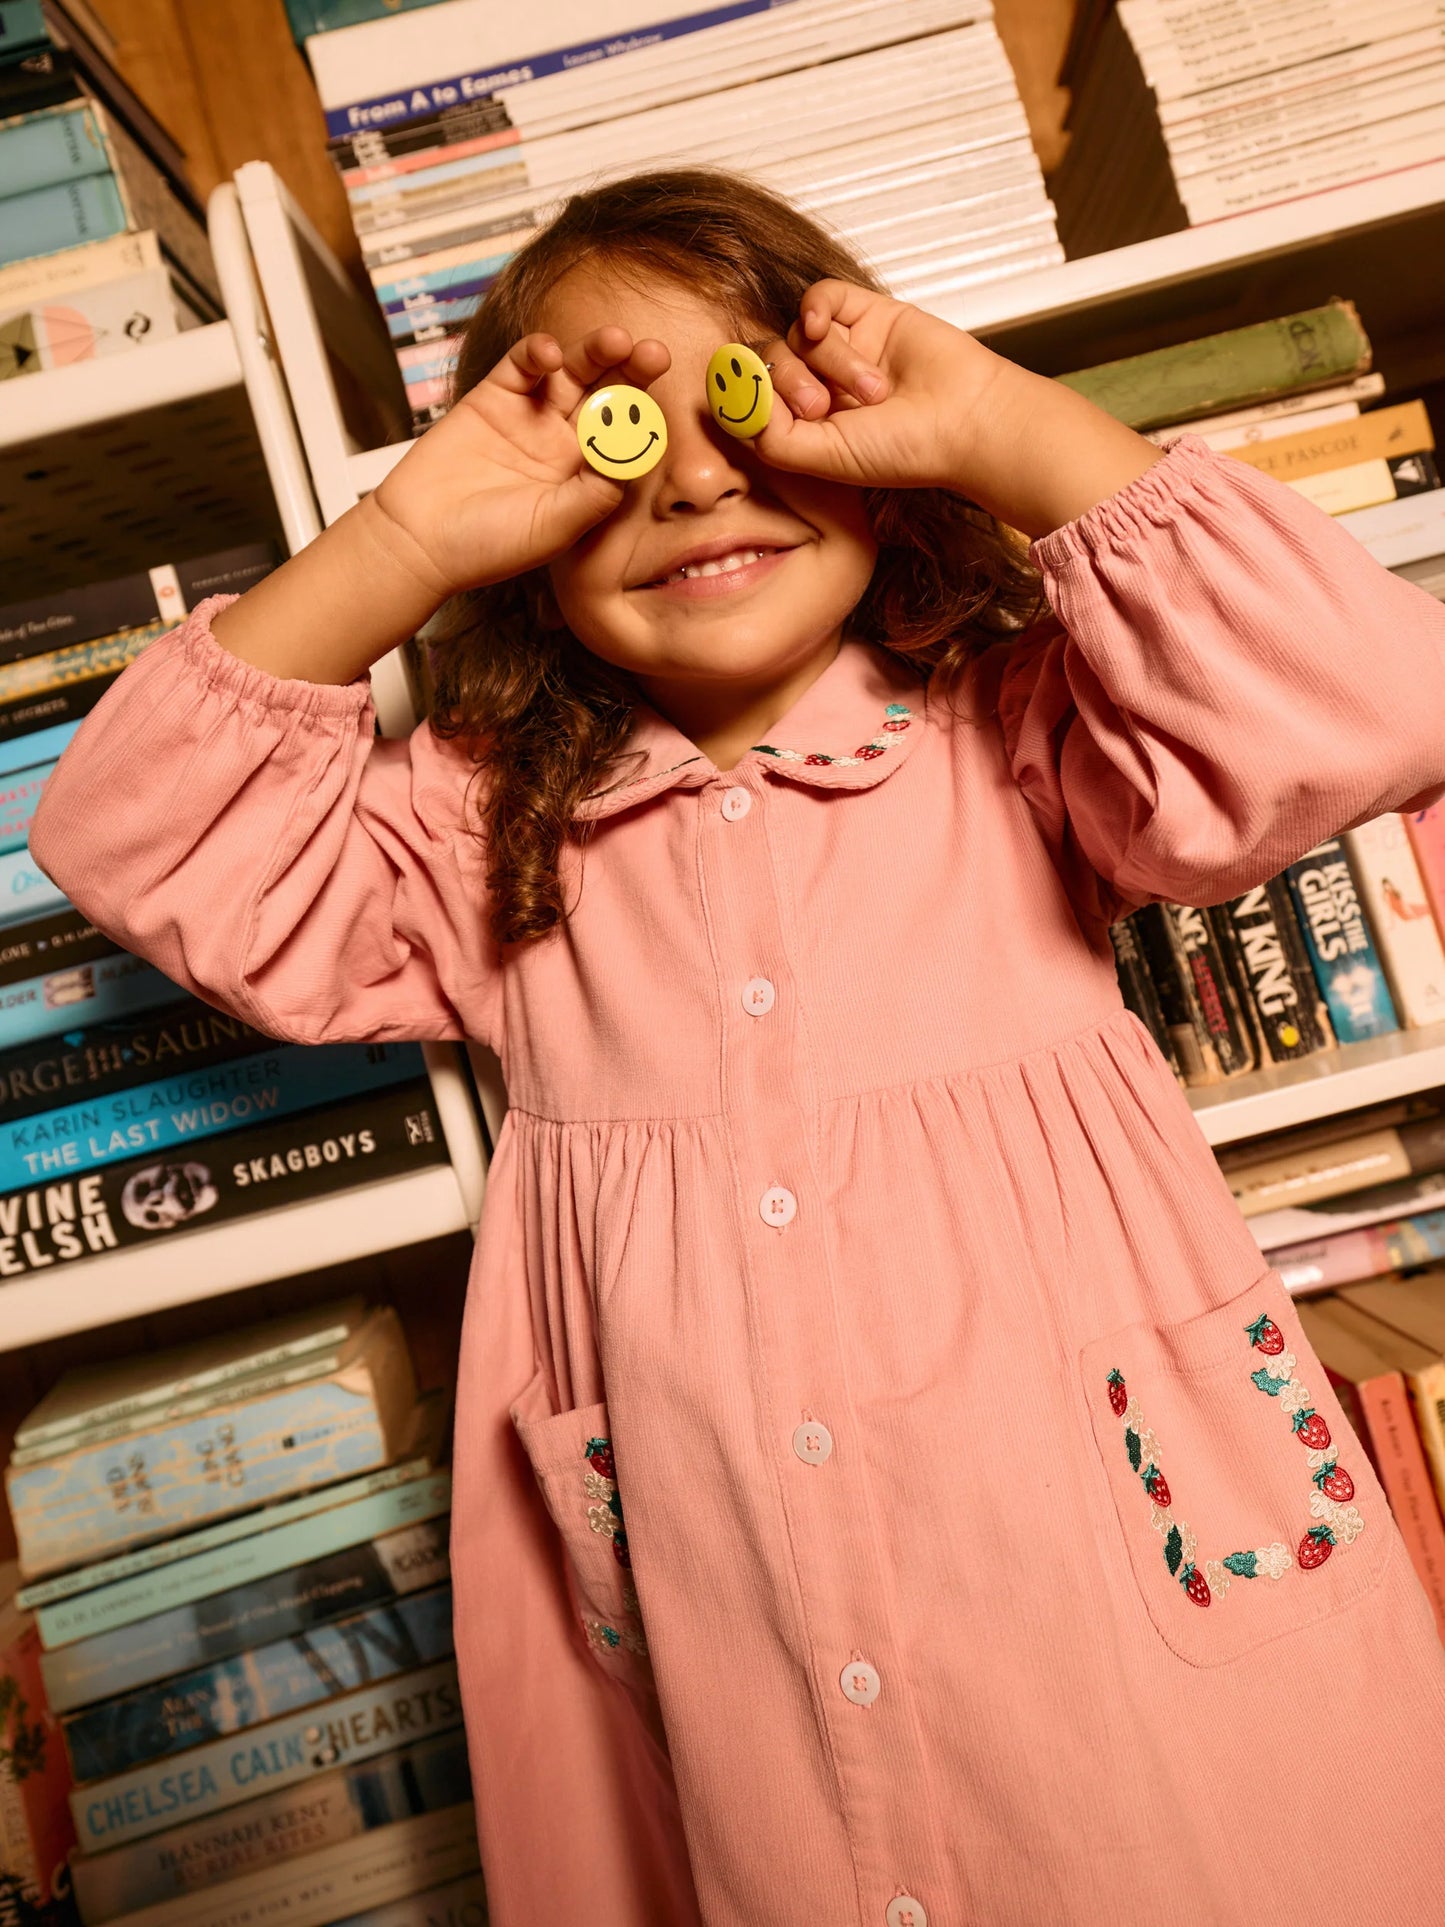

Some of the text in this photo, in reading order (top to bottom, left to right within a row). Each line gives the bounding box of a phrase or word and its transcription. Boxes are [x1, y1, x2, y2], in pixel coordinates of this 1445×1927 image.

[348, 99, 408, 129] From
[410, 89, 431, 113] A
[431, 86, 459, 107] to
[460, 64, 535, 99] Eames
[1285, 434, 1362, 466] PASCOE
[1168, 904, 1210, 954] NG
[1299, 868, 1349, 963] GIRLS
[1323, 860, 1370, 953] KISS THE
[0, 942, 31, 966] OVE
[76, 925, 99, 940] LAW
[1238, 922, 1299, 1018] KING
[0, 1052, 85, 1101] ORGE
[11, 1057, 282, 1151] KARIN SLAUGHTER
[22, 1086, 281, 1177] THE LAST WIDOW
[232, 1128, 378, 1188] SKAGBOYS
[0, 1174, 105, 1238] VINE
[0, 1209, 120, 1278] ELSH
[86, 1684, 458, 1837] CHELSEA CAIN HEARTS
[157, 1797, 332, 1872] HANNAH KENT
[265, 1821, 328, 1860] RITES
